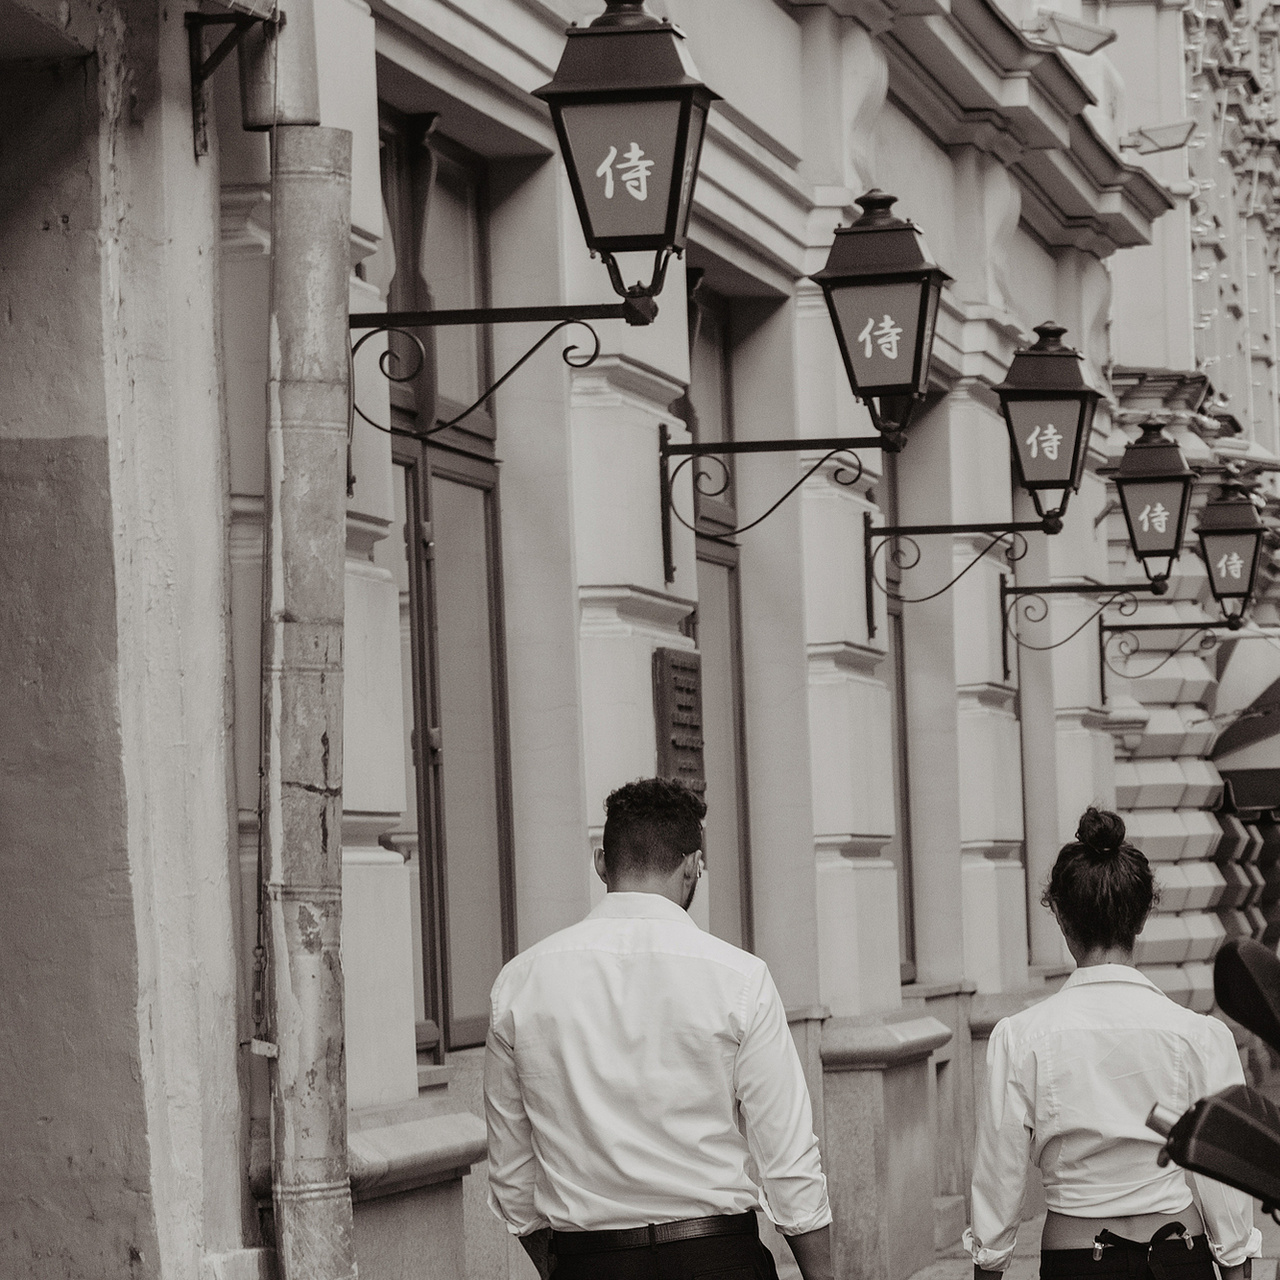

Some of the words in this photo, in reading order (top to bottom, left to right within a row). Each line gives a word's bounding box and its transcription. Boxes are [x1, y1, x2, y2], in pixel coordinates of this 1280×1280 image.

[596, 141, 655, 201] 侍
[857, 314, 903, 360] 侍
[1025, 423, 1064, 461] 侍
[1138, 502, 1170, 533] 侍
[1217, 552, 1245, 579] 侍
